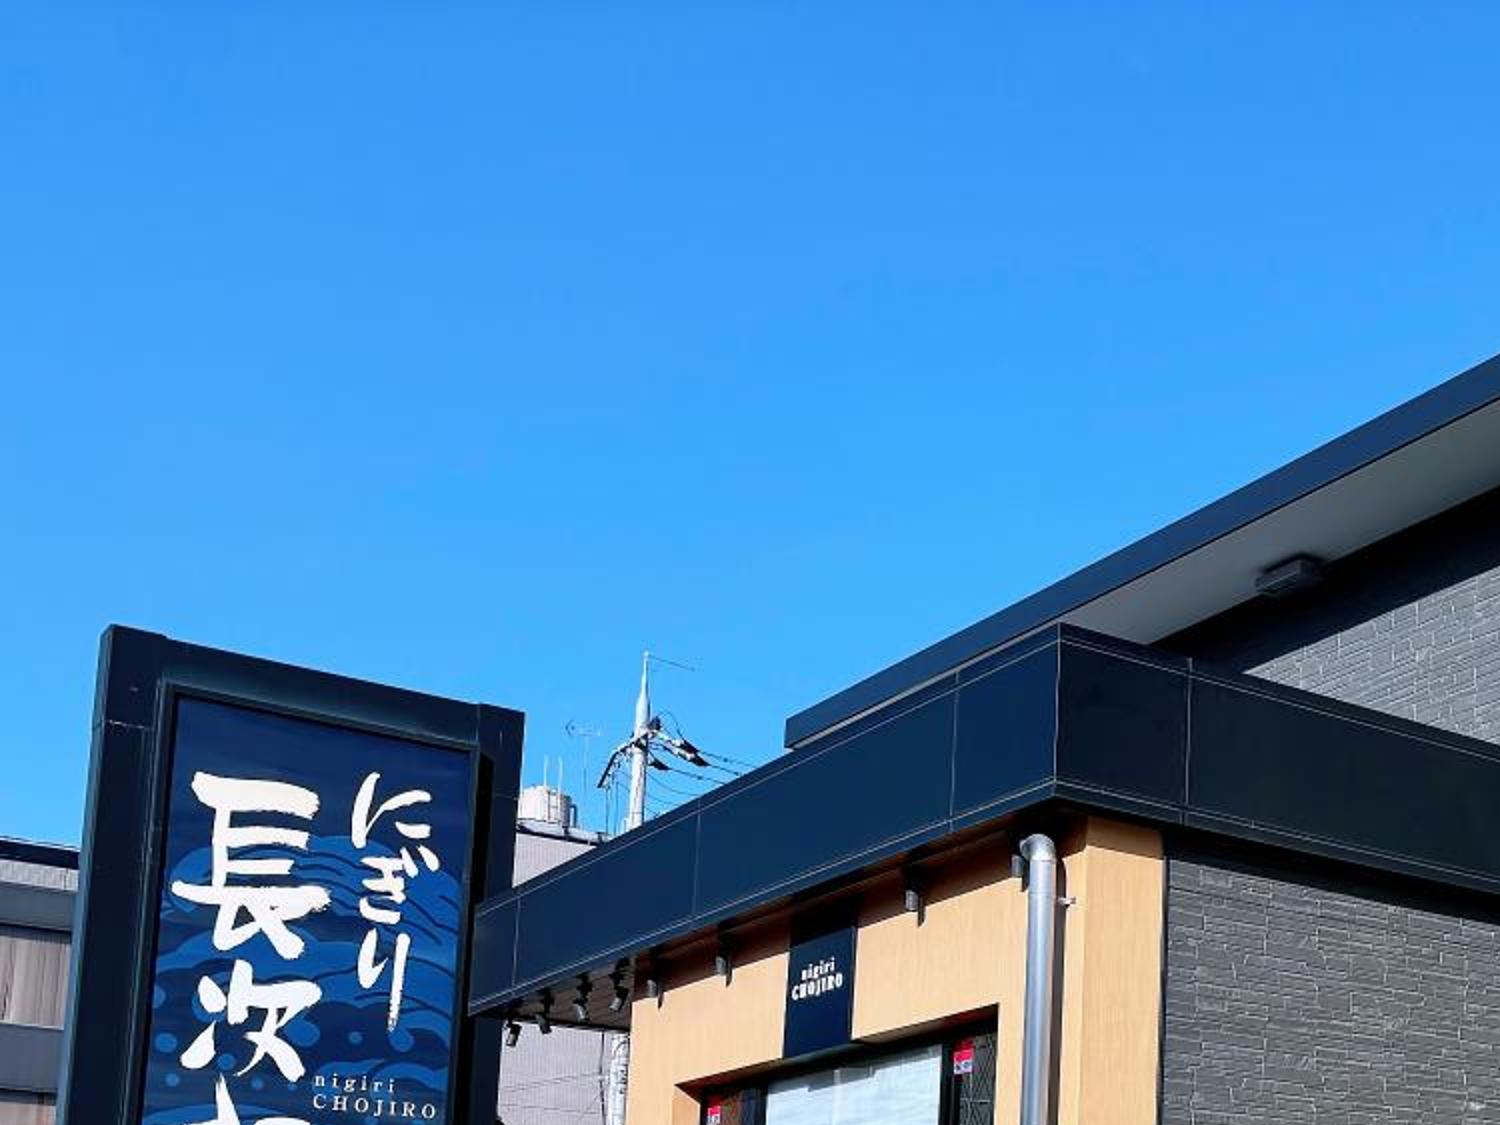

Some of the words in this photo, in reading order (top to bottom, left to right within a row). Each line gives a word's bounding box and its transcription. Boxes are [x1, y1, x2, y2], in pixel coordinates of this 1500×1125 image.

[351, 771, 440, 1033] にぎり
[791, 972, 843, 1001] CHOJIRO
[313, 1073, 395, 1094] nigiri
[312, 1094, 436, 1119] CHOJIRO
